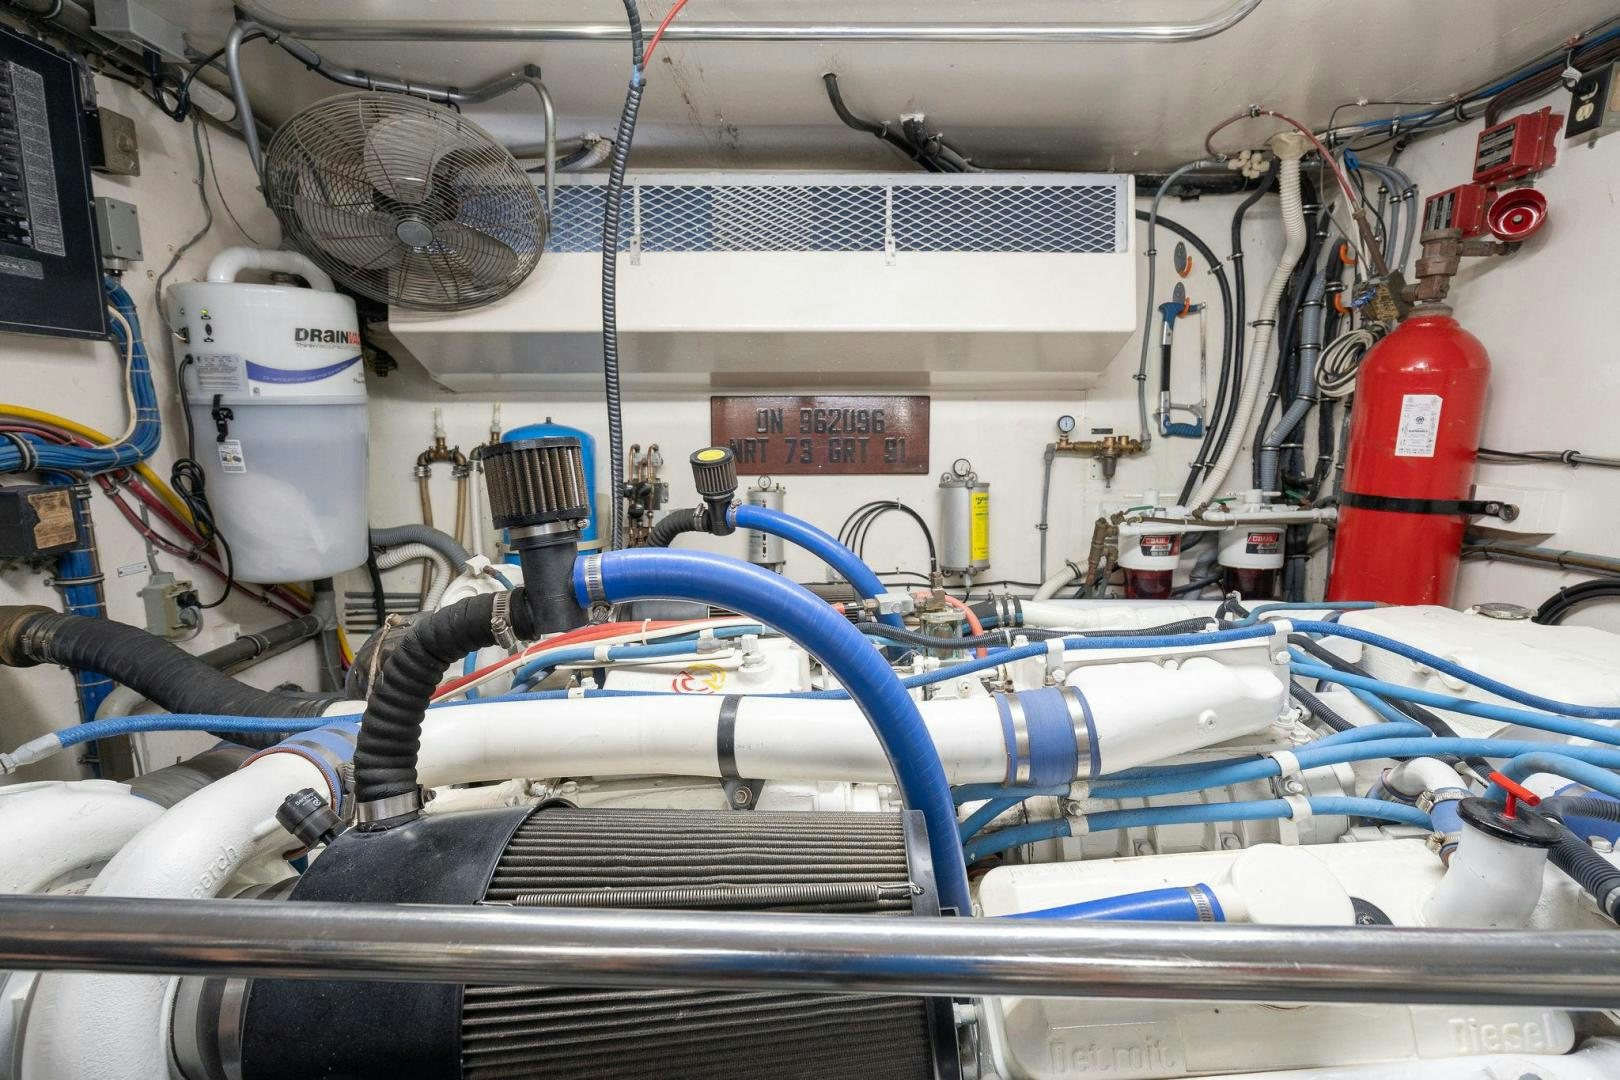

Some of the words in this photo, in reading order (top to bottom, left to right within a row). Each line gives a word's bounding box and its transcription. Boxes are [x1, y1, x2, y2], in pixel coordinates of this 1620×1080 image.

[756, 407, 783, 434] ON
[800, 407, 886, 434] 962096
[730, 437, 769, 464] NRT
[785, 437, 814, 464] 73
[828, 437, 870, 464] GRT
[884, 437, 907, 464] 91
[1049, 1035, 1177, 1075] Detroit
[1447, 1012, 1555, 1054] Diesel
